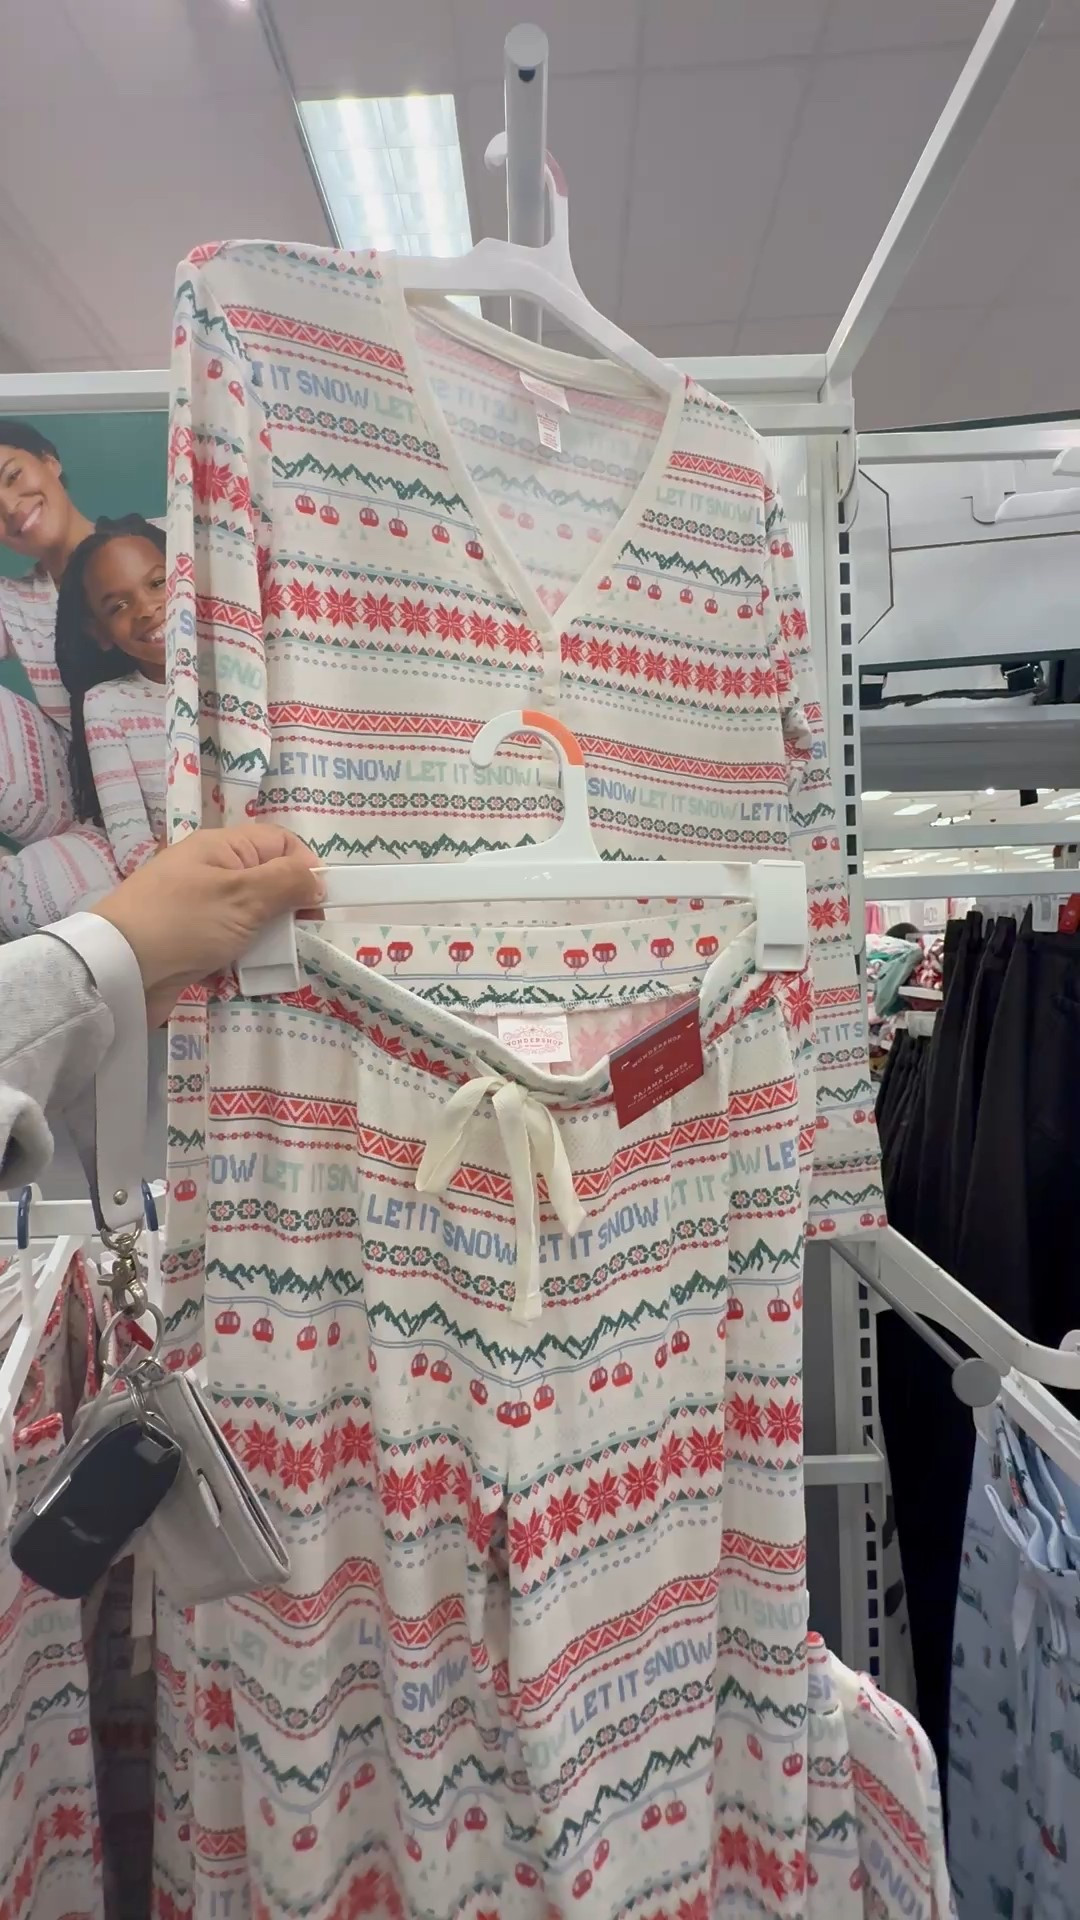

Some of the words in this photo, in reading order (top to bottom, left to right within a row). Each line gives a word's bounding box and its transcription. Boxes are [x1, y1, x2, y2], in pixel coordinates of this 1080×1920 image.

[270, 364, 291, 391] IT
[296, 369, 369, 410] SNOW
[374, 391, 416, 424] LET
[656, 486, 686, 508] LET
[690, 492, 704, 512] IT
[706, 496, 754, 522] SNOW
[312, 754, 328, 778] IT
[333, 757, 401, 781] SNOW
[405, 760, 447, 782] LET
[453, 763, 469, 784] IT
[474, 765, 532, 786] SNOW
[587, 777, 637, 804] SNOW
[640, 788, 667, 810] LET
[671, 794, 686, 813] IT
[689, 796, 738, 819] SNOW
[741, 802, 774, 821] LET
[263, 1153, 304, 1193] LET
[765, 1138, 797, 1171] LE
[366, 1193, 416, 1230] LET
[419, 1203, 441, 1234] IT
[442, 1220, 517, 1266] SNOW
[570, 1229, 593, 1260] IT
[598, 1197, 659, 1250] SNOW
[695, 1175, 715, 1203] IT
[402, 1655, 468, 1712] SNOW
[570, 1681, 612, 1735] LET
[617, 1669, 639, 1703] IT
[643, 1632, 713, 1686] SNOW
